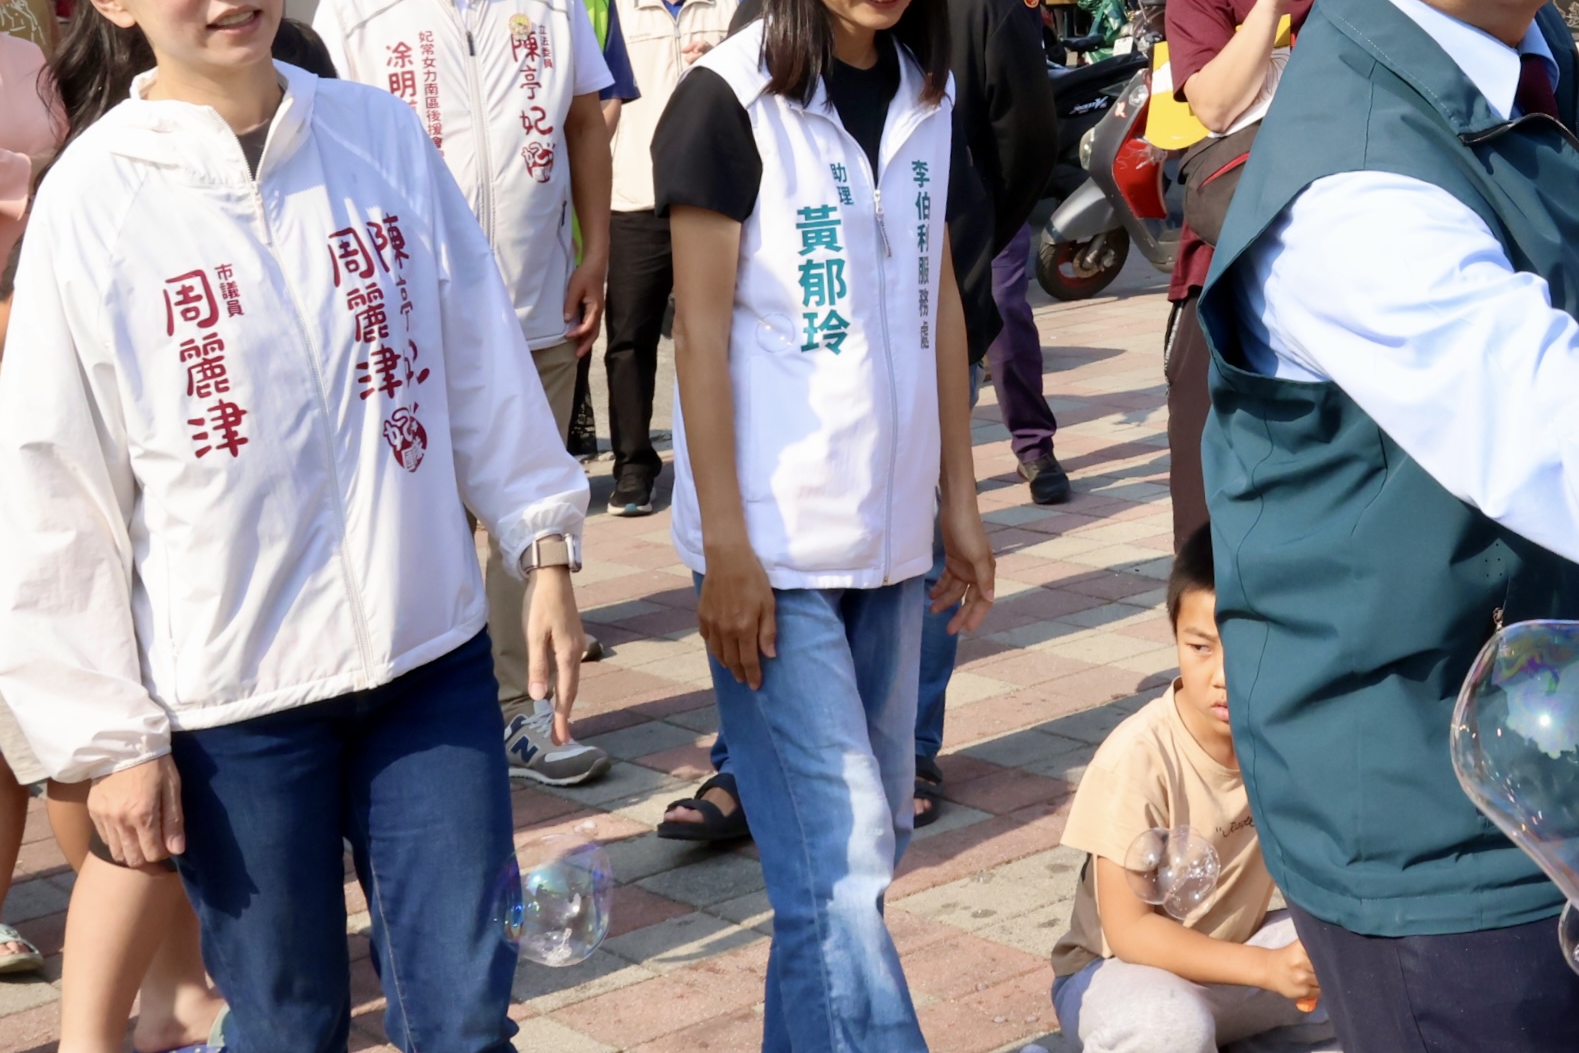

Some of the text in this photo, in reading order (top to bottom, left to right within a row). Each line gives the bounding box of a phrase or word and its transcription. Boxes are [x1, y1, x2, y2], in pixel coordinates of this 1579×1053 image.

[510, 30, 554, 136] 陳亭妃
[539, 24, 553, 68] 立法委員
[829, 162, 854, 206] 助理
[214, 263, 244, 318] 市議員
[327, 226, 402, 400] 周麗津
[796, 204, 850, 355] 黃郁玲
[163, 269, 249, 459] 周麗津
